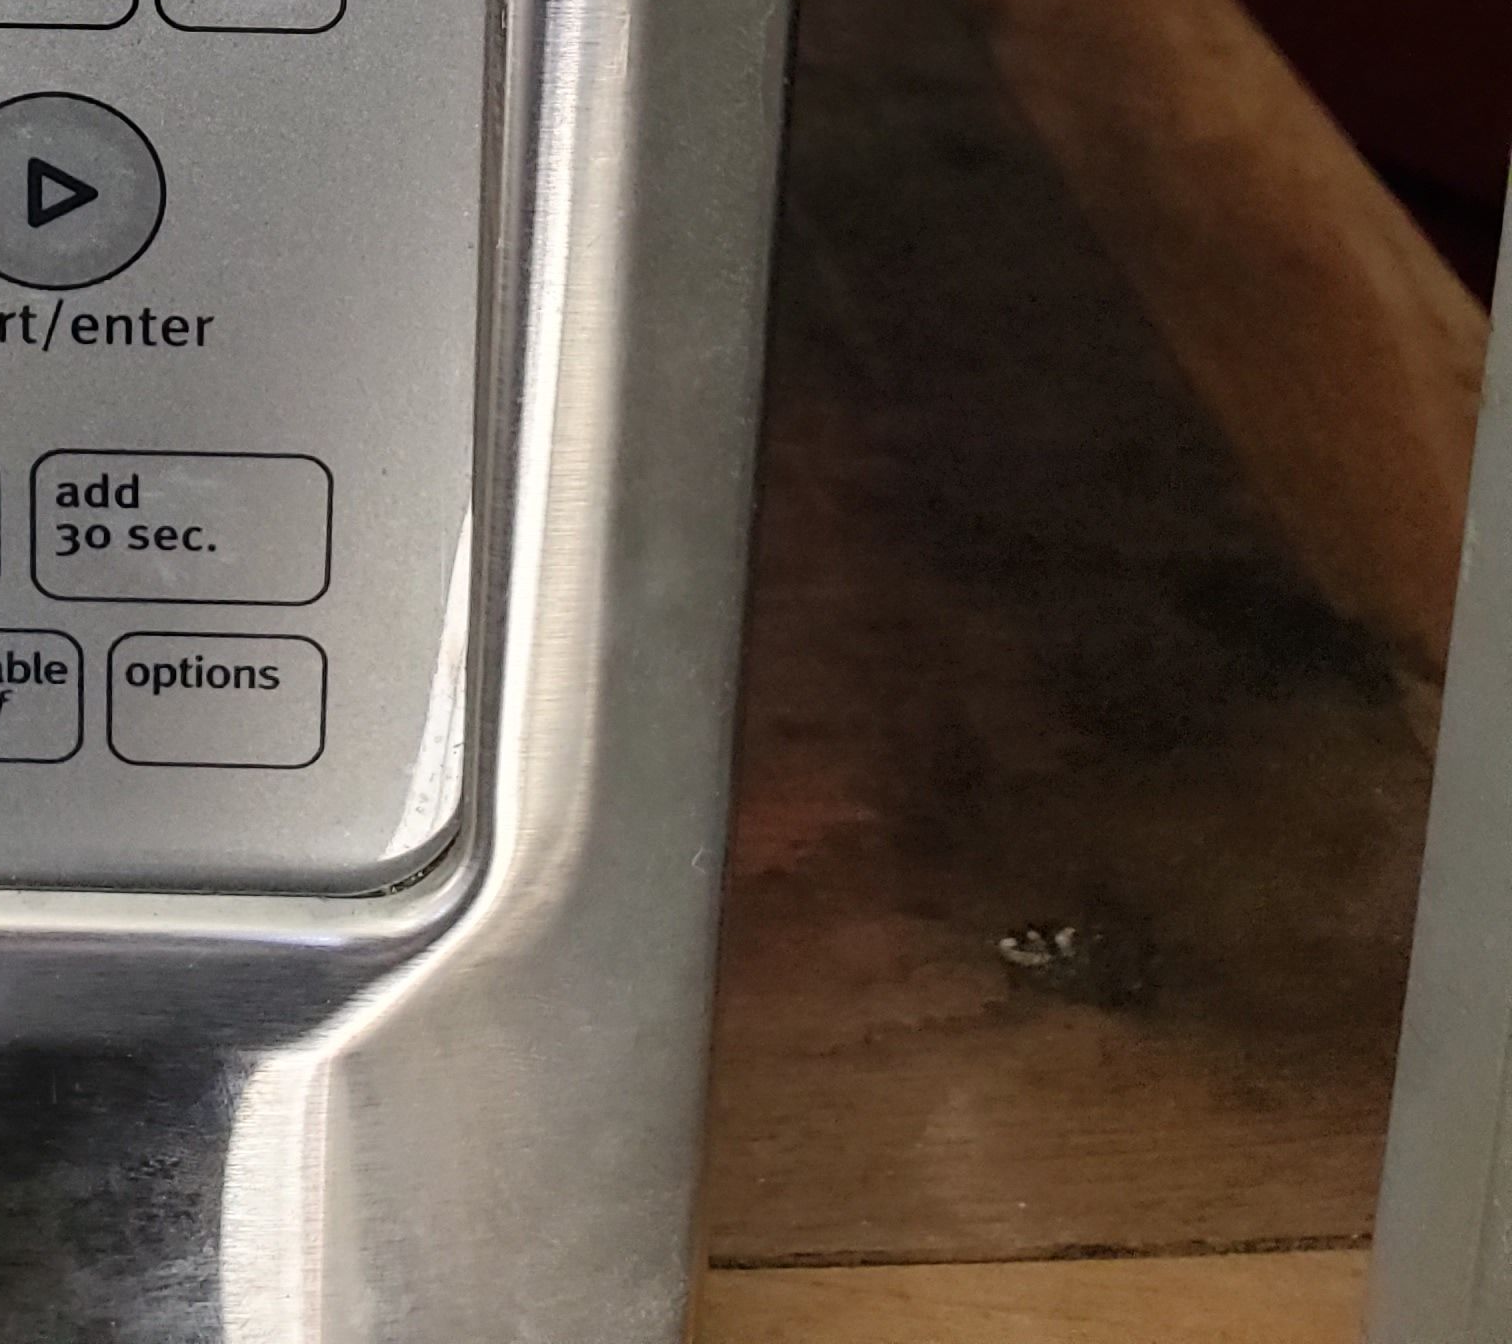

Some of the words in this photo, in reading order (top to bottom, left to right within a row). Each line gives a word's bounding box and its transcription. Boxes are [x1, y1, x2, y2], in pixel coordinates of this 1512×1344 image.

[56, 473, 139, 509] add
[56, 524, 111, 556] 30
[128, 525, 216, 552] sec.
[126, 655, 280, 695] options
